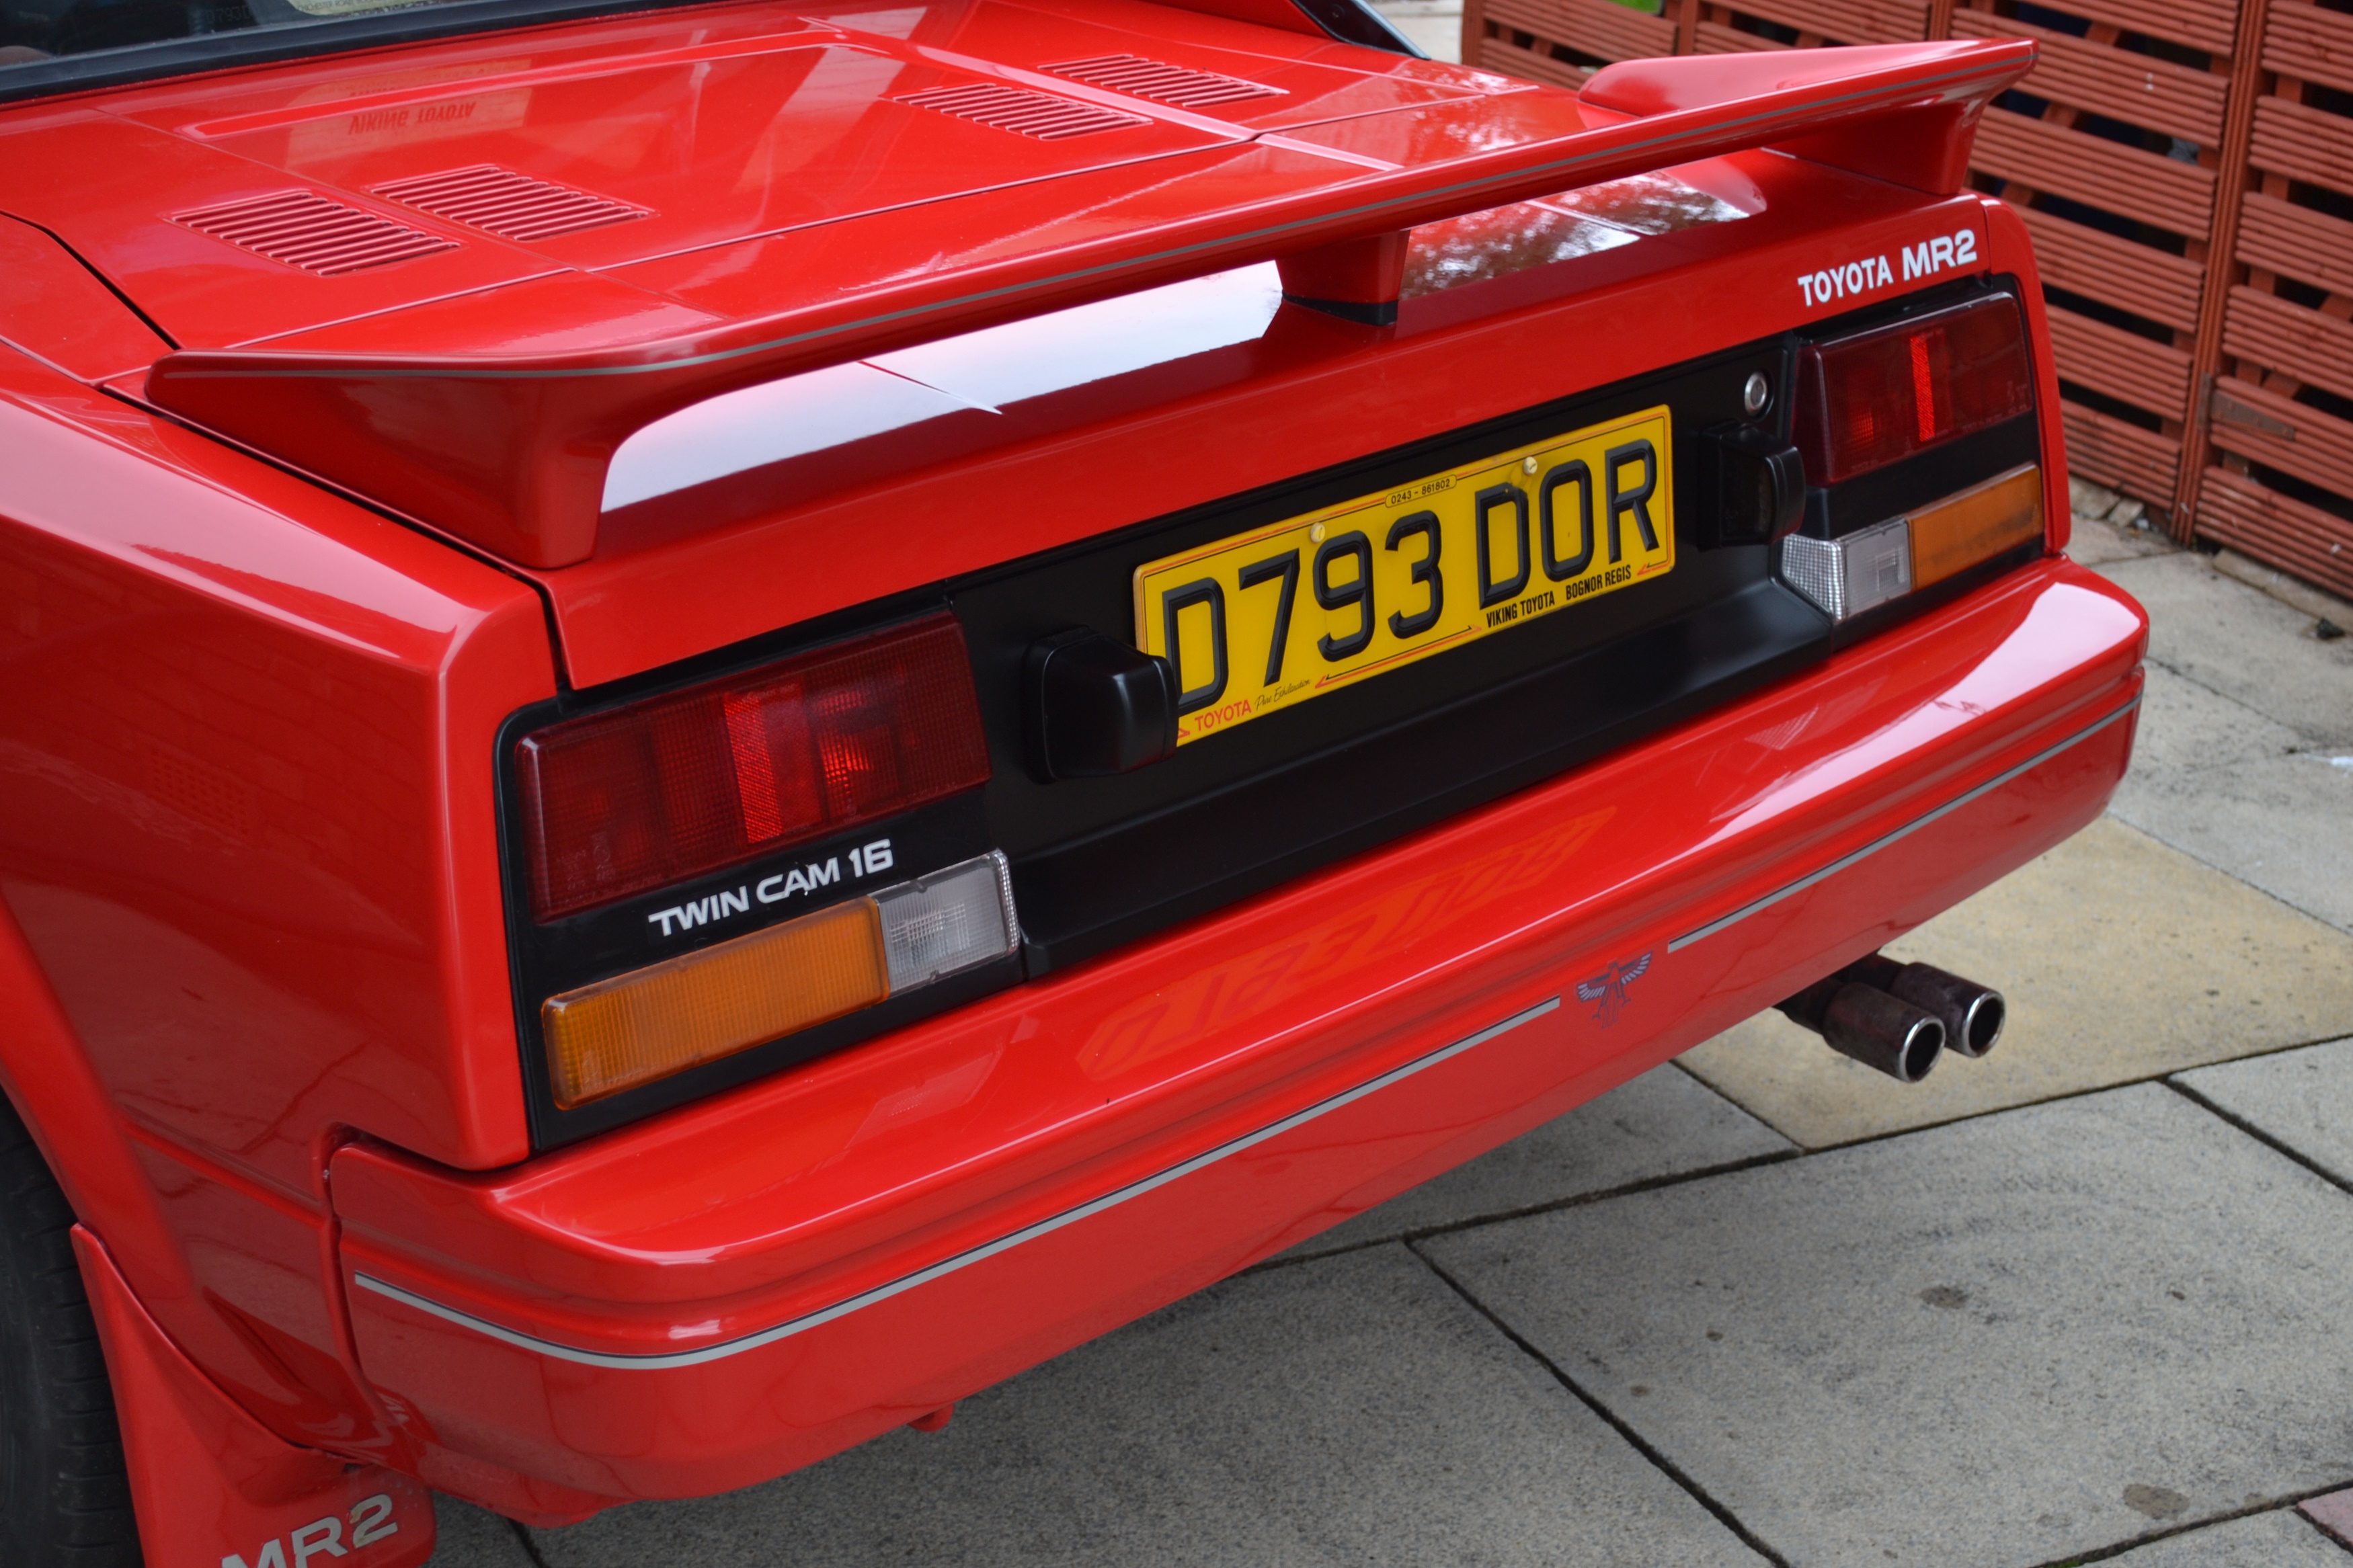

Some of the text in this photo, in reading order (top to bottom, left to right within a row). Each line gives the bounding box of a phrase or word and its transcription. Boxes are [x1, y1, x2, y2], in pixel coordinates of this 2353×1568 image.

[1797, 229, 1977, 307] TOYOTA MR2
[1391, 491, 1412, 504] 0243
[1422, 479, 1450, 495] 861802
[1162, 438, 1660, 717] D793 DOR
[1486, 565, 1631, 628] VIKING TOYOTA BOGNOR REGIS
[1195, 699, 1252, 731] TOYOTA
[1254, 694, 1272, 711] Pure
[648, 838, 894, 936] TWIN CAM 16
